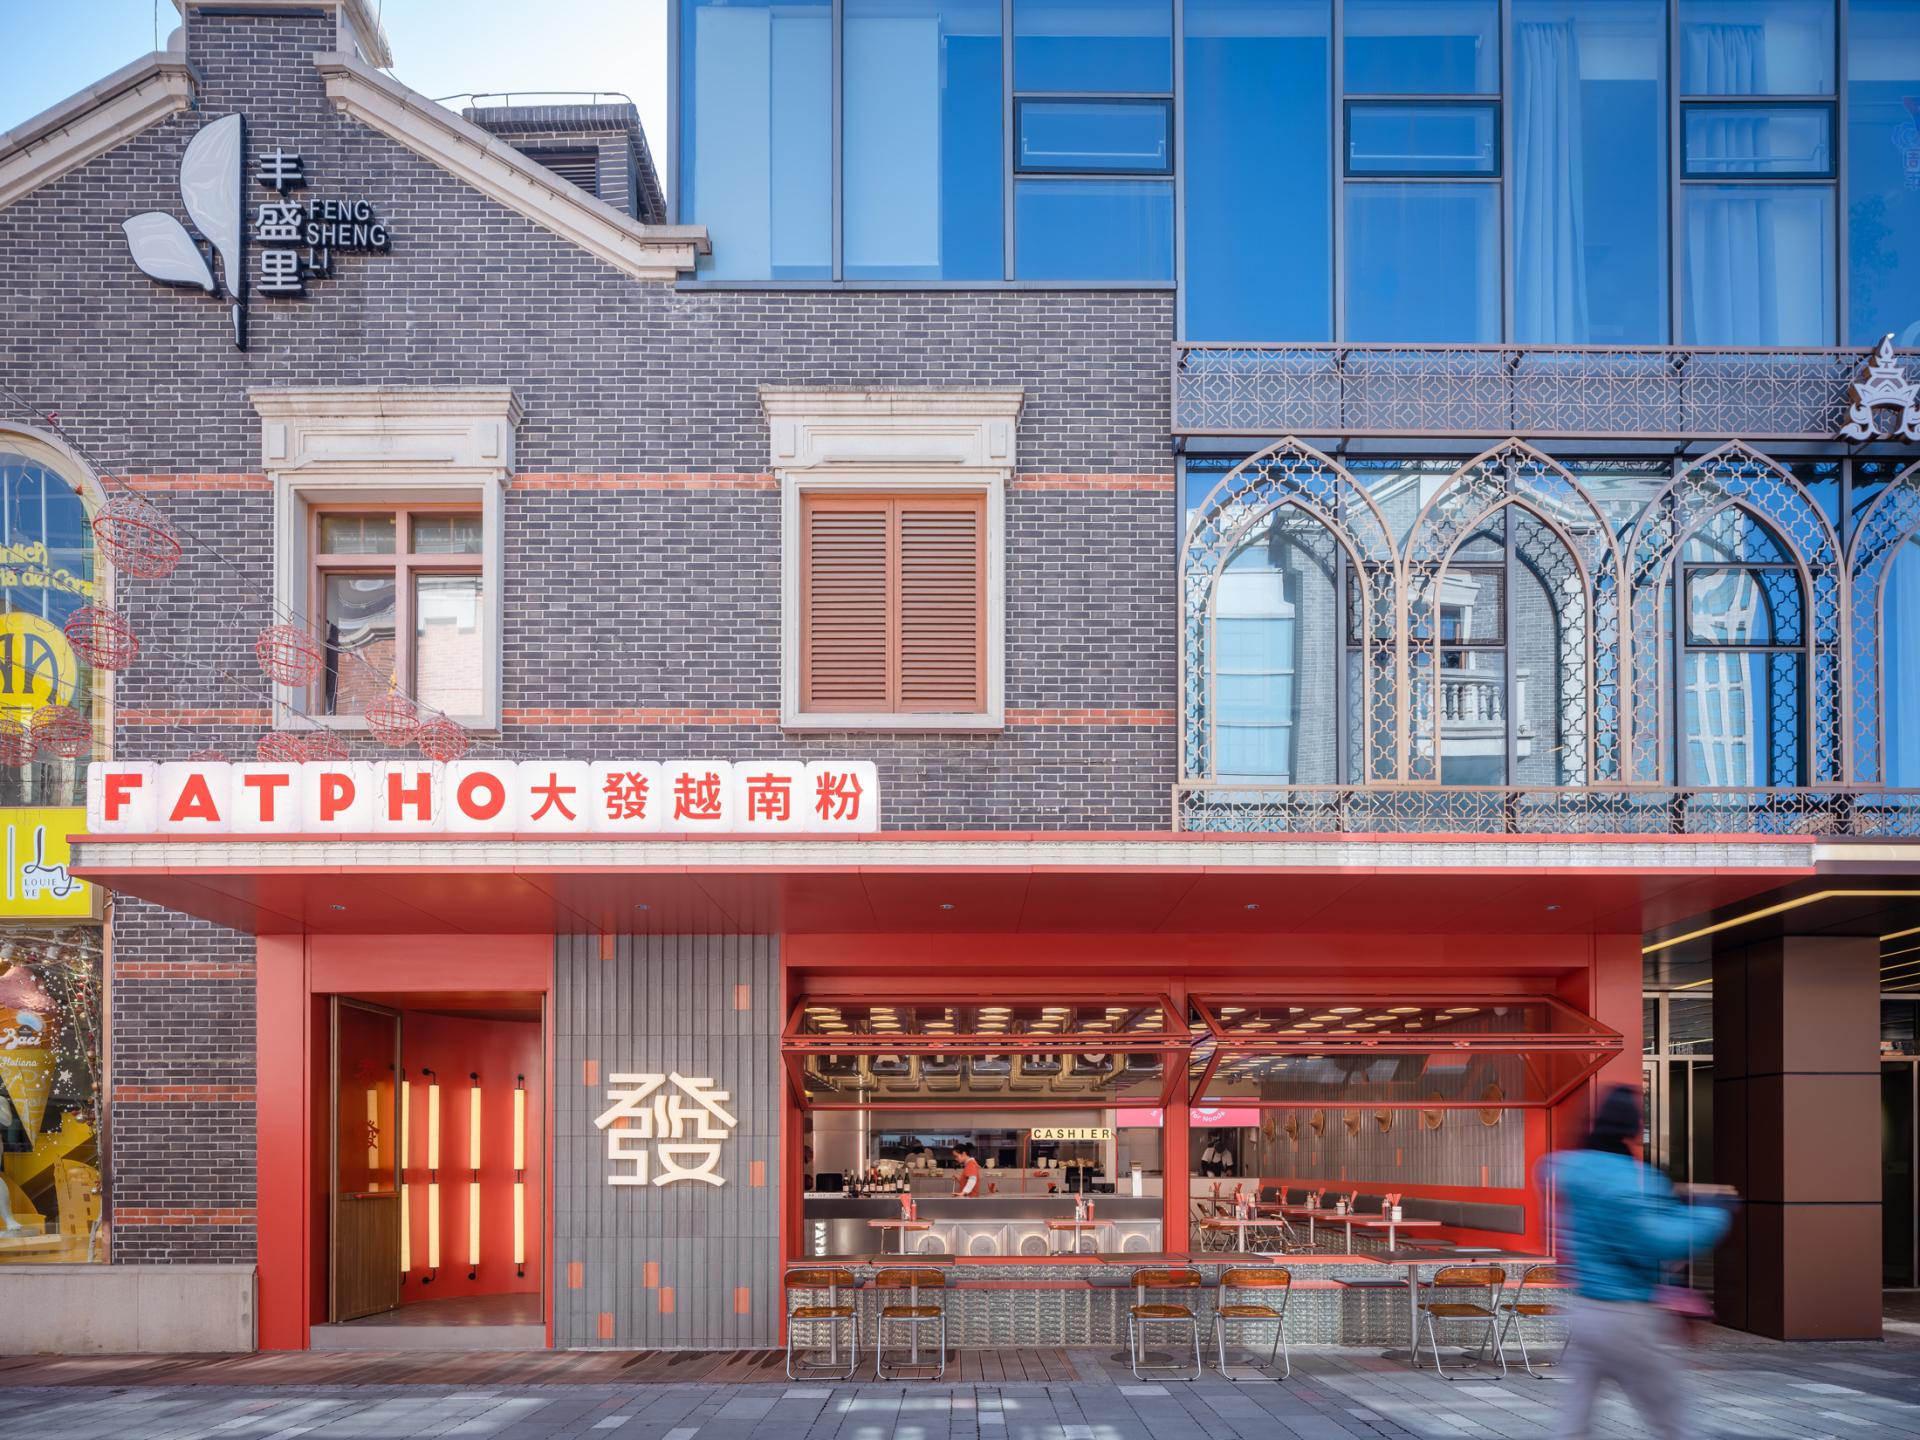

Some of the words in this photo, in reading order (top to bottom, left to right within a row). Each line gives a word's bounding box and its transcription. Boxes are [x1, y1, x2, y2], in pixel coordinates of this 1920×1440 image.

[255, 147, 302, 290] 丰盛里
[309, 199, 370, 221] FENG
[306, 223, 385, 246] SHENG
[309, 247, 328, 269] LI
[104, 771, 506, 823] FATPHO
[530, 771, 864, 822] 大發越南粉
[1033, 1128, 1110, 1139] CASHIER
